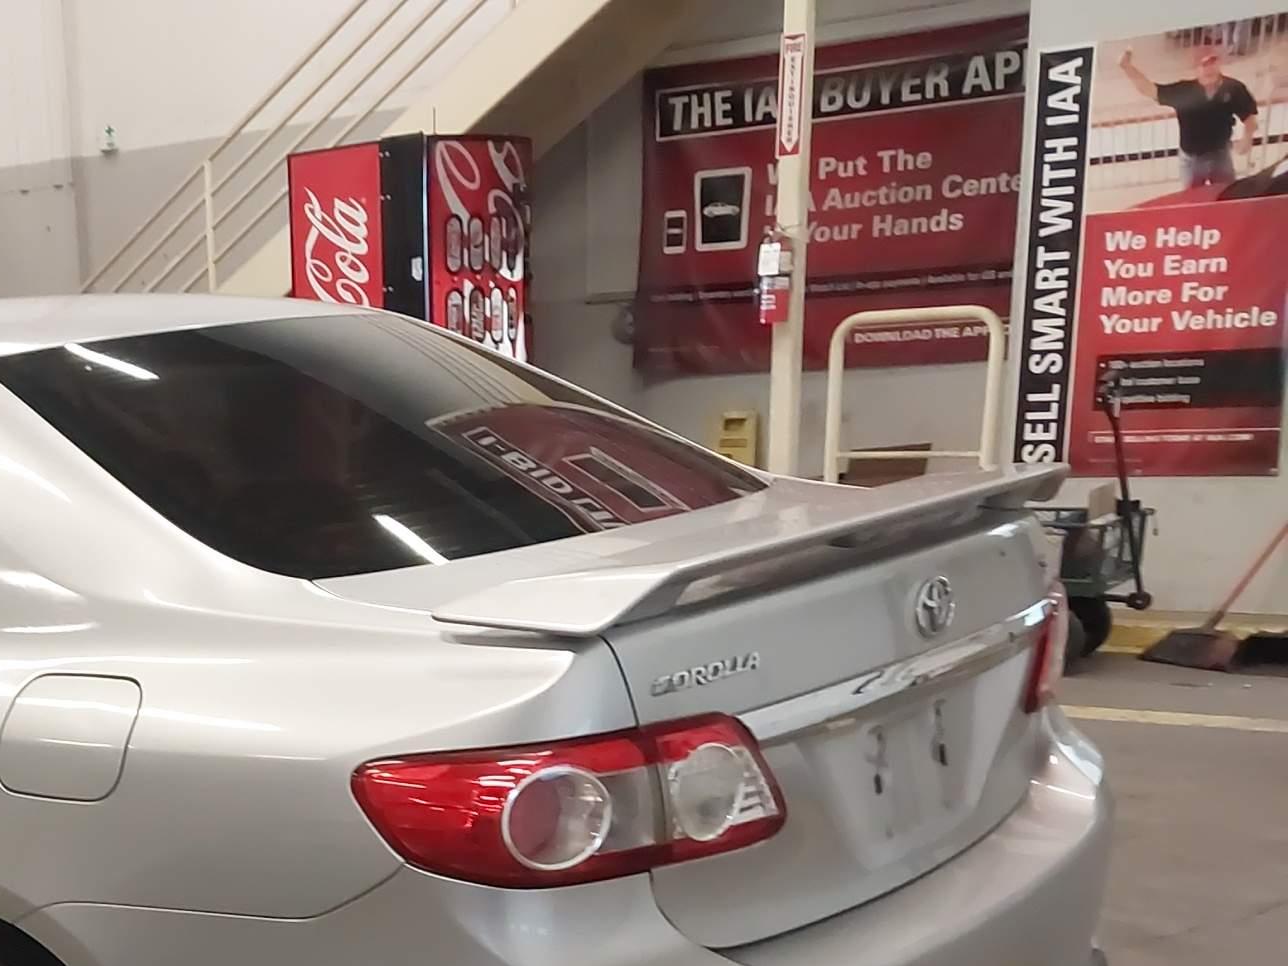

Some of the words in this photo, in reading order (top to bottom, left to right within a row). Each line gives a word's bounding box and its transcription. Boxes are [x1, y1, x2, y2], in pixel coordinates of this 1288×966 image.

[668, 90, 733, 131] THE
[743, 86, 777, 123] IA
[819, 61, 951, 112] BUYER
[962, 49, 1028, 94] AP
[1045, 56, 1084, 126] IAA
[818, 155, 868, 180] Put
[877, 149, 933, 174] The
[822, 182, 933, 211] Auction
[941, 172, 1022, 199] Cente
[1038, 136, 1079, 237] WITH
[872, 208, 965, 238] Hands
[1104, 230, 1147, 251] We
[1155, 225, 1221, 250] Help
[304, 187, 369, 307] Cola
[1103, 258, 1154, 279] You
[1163, 254, 1228, 276] Earn
[1029, 246, 1071, 374] SMART
[1100, 286, 1173, 307] More
[1181, 281, 1229, 303] For
[853, 330, 933, 344] DOWNLOAD
[934, 326, 961, 339] THE
[1099, 314, 1163, 335] Your
[1170, 306, 1278, 331] Vehicle
[1021, 383, 1061, 464] SELL
[650, 651, 761, 697] COROLLA
